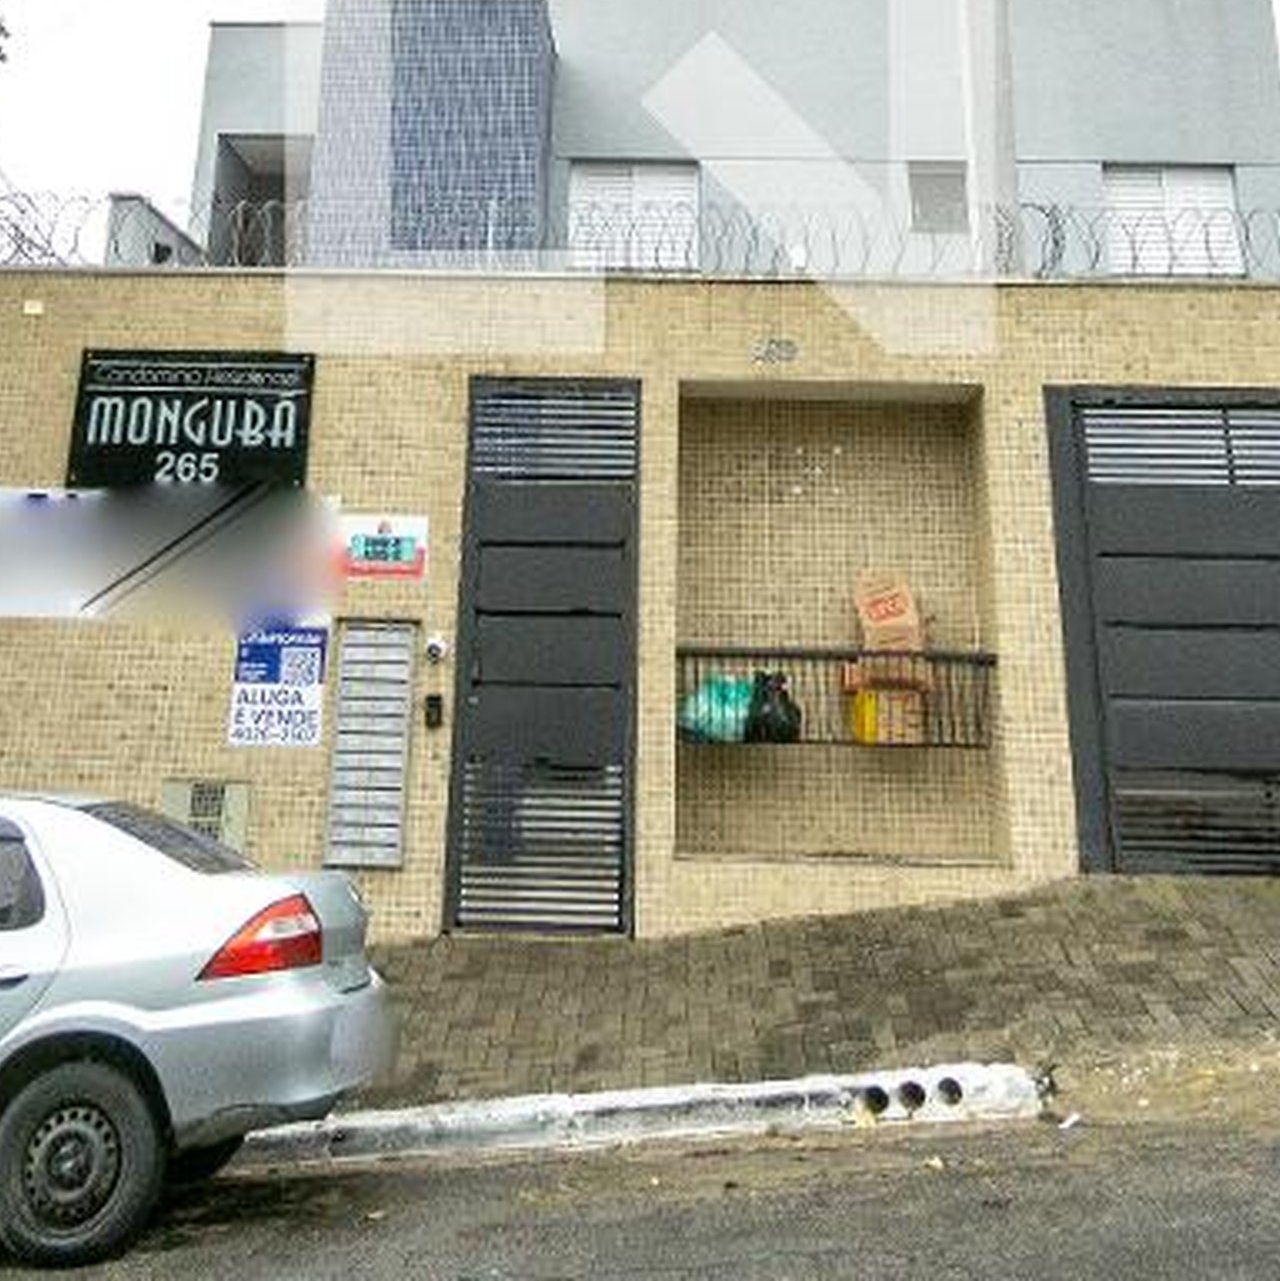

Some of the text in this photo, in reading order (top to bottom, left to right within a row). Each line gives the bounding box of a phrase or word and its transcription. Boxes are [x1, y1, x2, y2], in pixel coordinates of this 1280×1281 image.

[154, 451, 220, 483] 265
[236, 688, 305, 706] ALUGA
[234, 708, 320, 730] E VENDE
